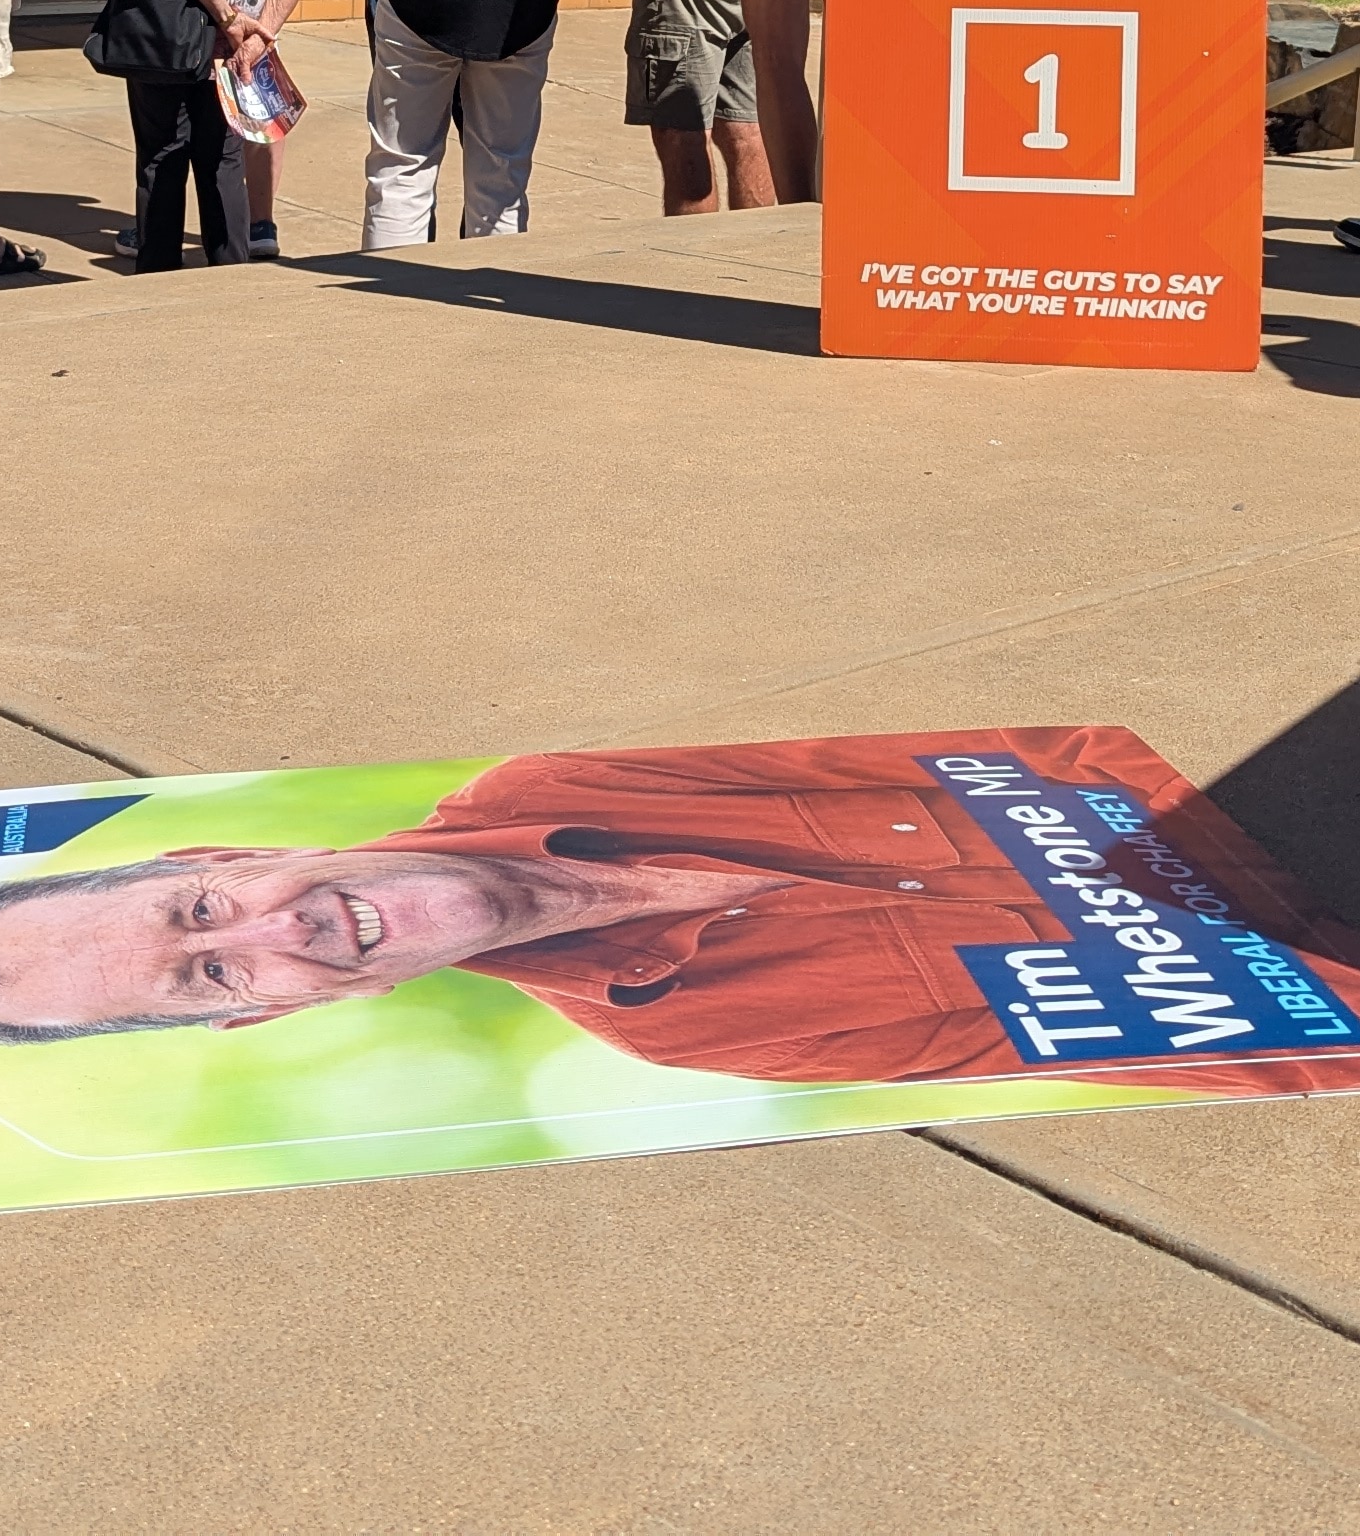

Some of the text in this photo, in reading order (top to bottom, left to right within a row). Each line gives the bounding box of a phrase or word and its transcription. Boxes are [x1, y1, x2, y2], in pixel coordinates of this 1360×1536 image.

[1022, 53, 1069, 150] 1
[861, 263, 1223, 296] I'VE GOT THE GUTS TO SAY
[875, 289, 1207, 320] WHAT YOU'RE THINKING
[1, 804, 28, 855] AUSTRALIA
[1076, 789, 1194, 880] CHAFFEY
[934, 755, 1256, 1049] Whetstone MP
[1175, 879, 1247, 929] FOR
[1004, 947, 1124, 1057] Tim
[1220, 930, 1352, 1036] LIBERAL
